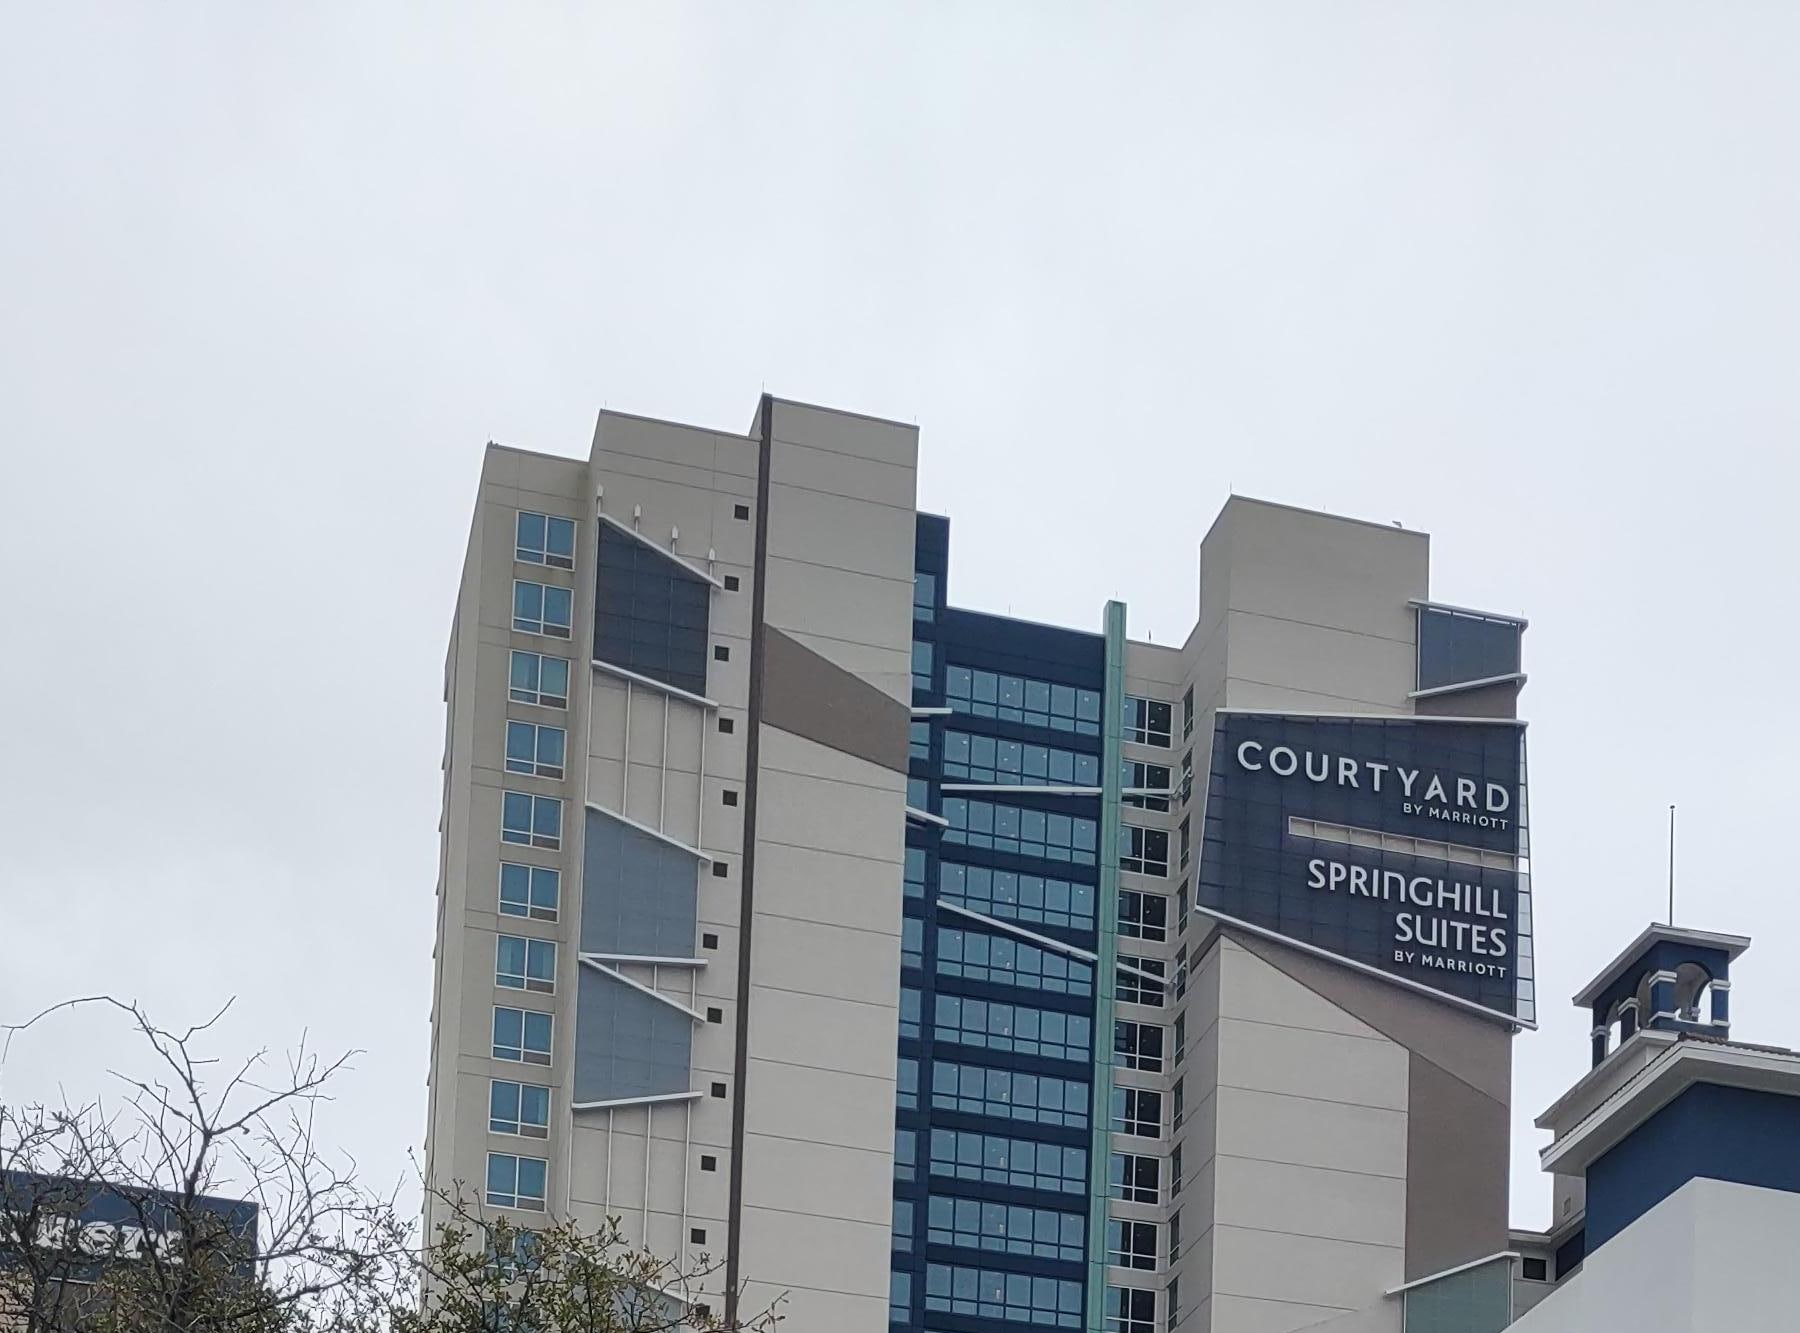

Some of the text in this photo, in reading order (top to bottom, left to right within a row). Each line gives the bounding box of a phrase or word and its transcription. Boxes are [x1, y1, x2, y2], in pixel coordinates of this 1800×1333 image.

[1237, 740, 1510, 813] COURTYARD
[1403, 803, 1509, 831] BY MARRIOTT
[1307, 858, 1508, 920] SPRINGHILL
[1394, 912, 1508, 958] SUITES
[1394, 951, 1508, 980] BY MARRIOTT
